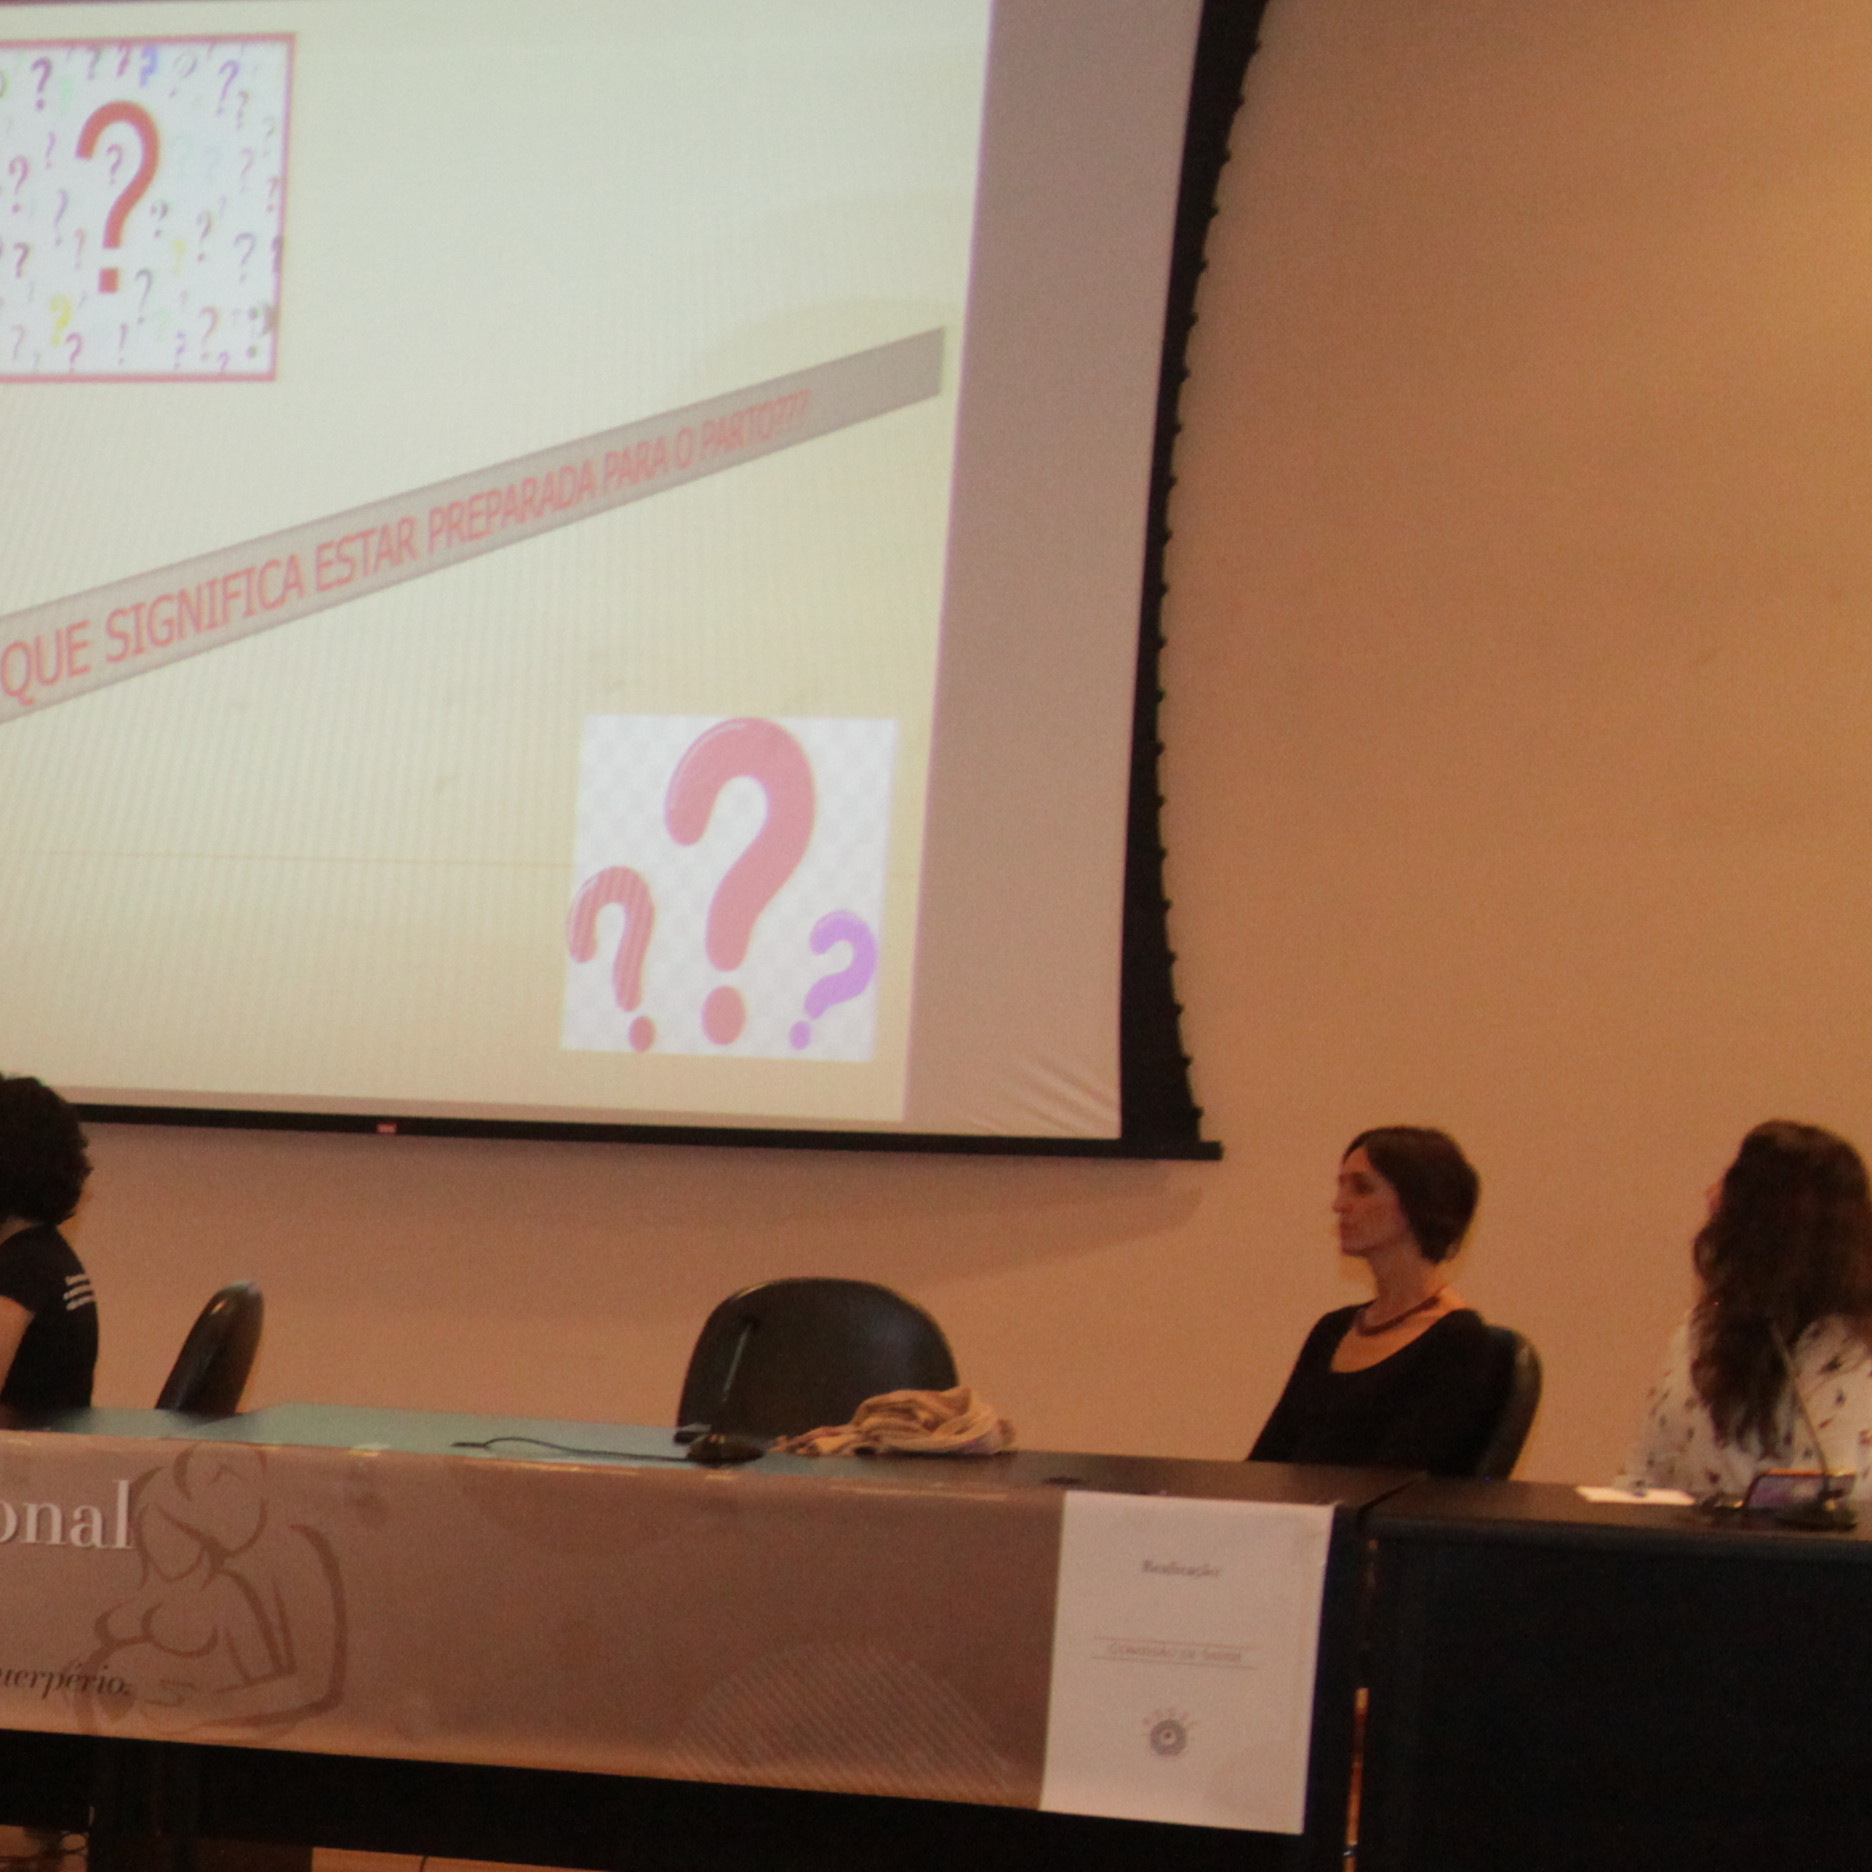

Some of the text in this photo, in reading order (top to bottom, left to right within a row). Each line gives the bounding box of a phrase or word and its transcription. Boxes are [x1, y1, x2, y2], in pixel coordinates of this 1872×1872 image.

[0, 620, 92, 705] QUE
[105, 553, 306, 664] SIGNIFICA
[314, 516, 418, 593] ESTAR
[427, 459, 597, 556] PREPARADA
[602, 440, 668, 494] PARA
[675, 427, 695, 470] O
